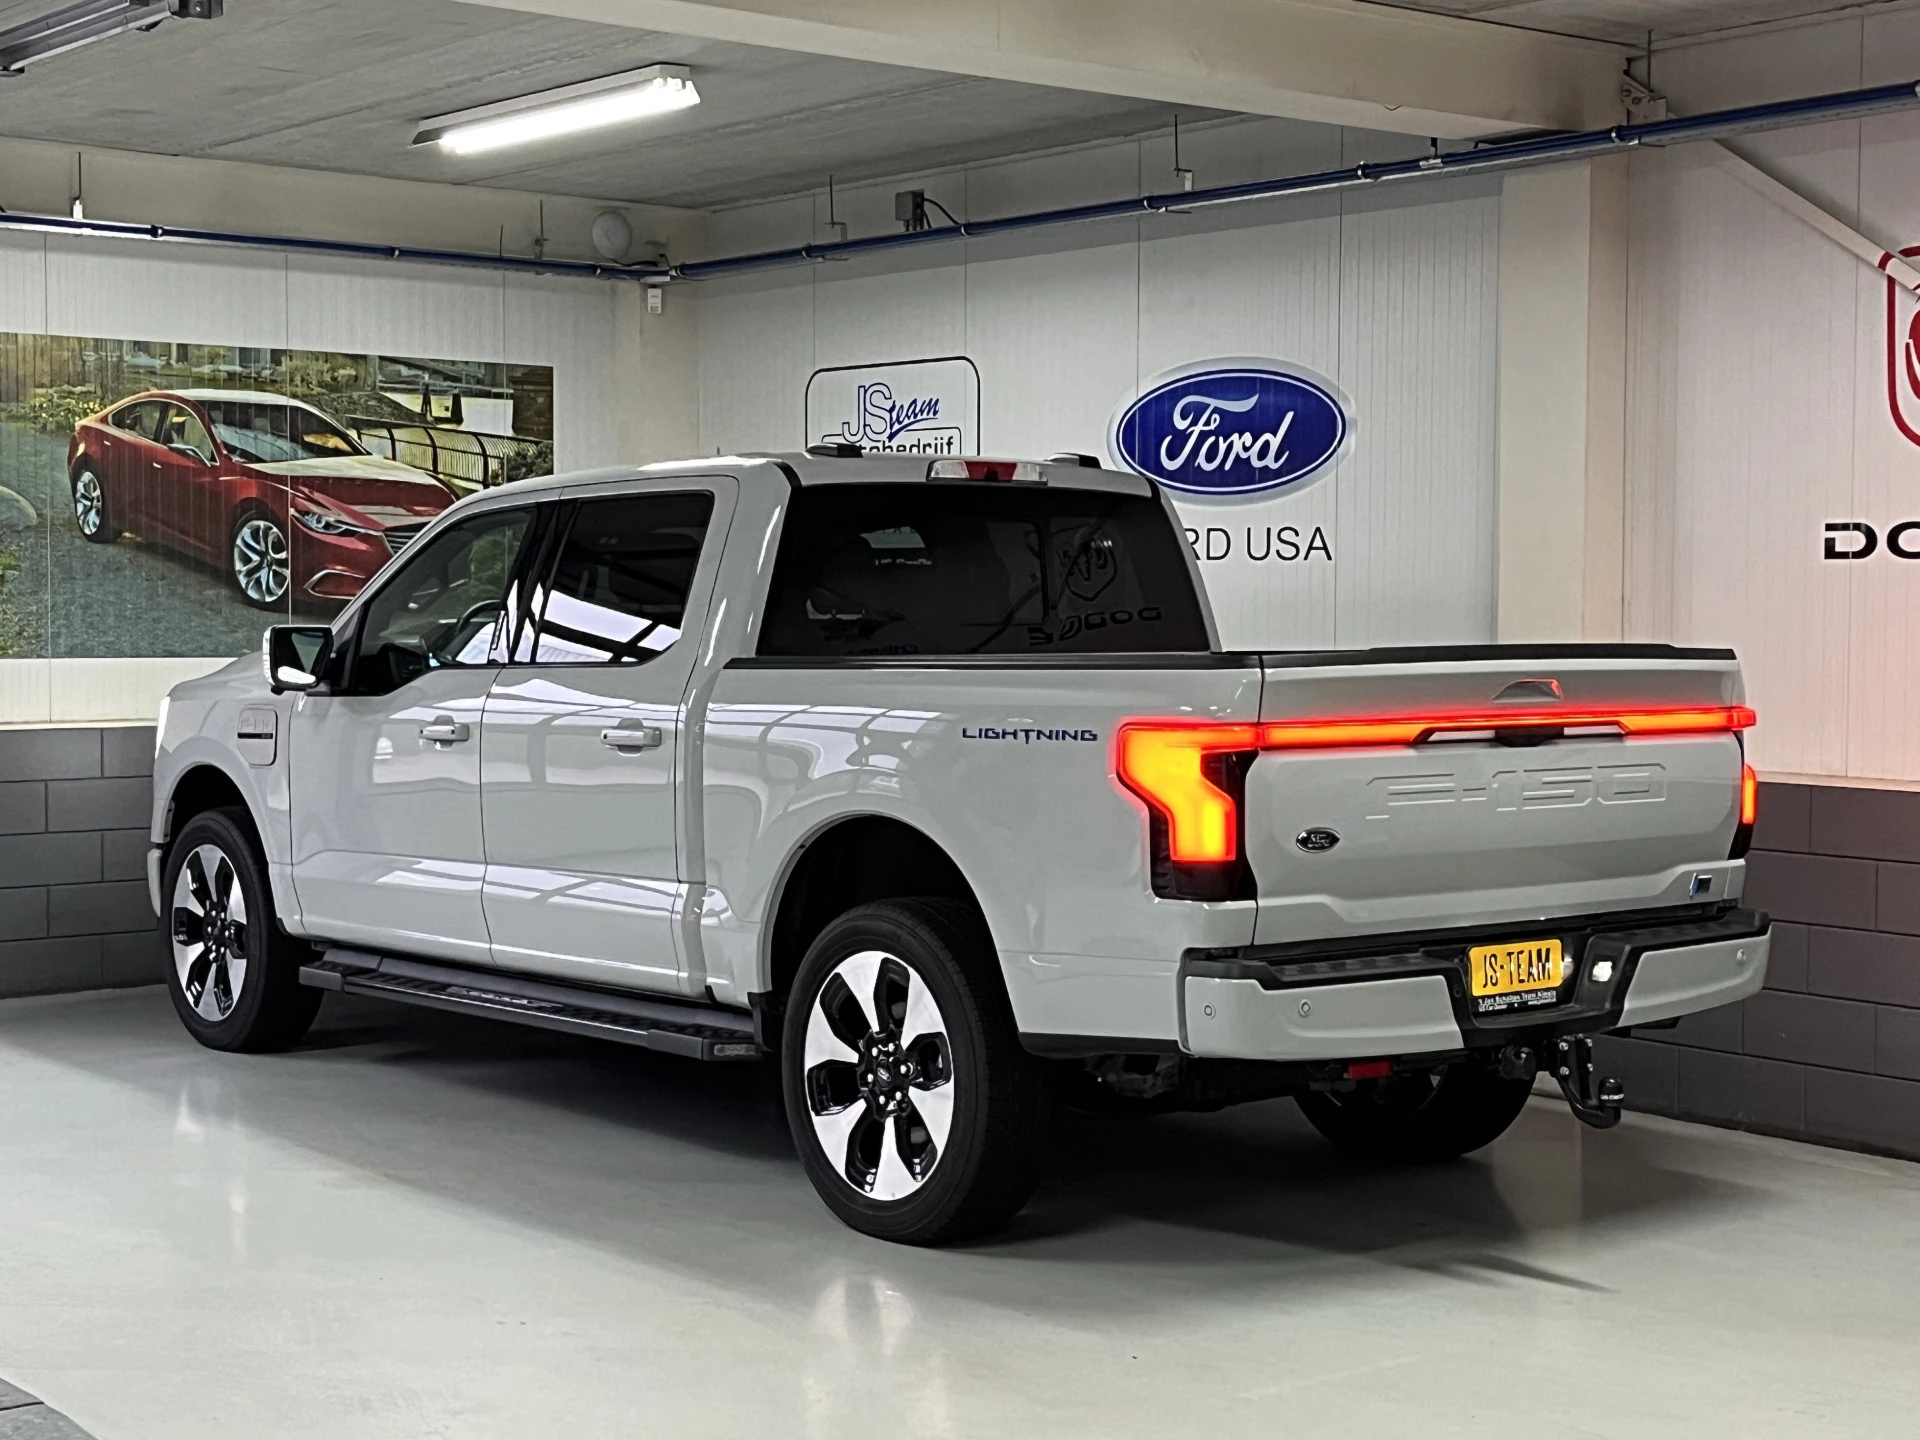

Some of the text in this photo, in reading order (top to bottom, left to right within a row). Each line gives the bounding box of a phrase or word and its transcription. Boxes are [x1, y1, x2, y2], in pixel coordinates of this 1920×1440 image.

[1160, 393, 1295, 472] Ford
[1246, 526, 1333, 561] USA
[962, 727, 1098, 745] LIGHTNING
[1364, 762, 1667, 820] F-150
[1482, 948, 1551, 988] JS-TEAM
